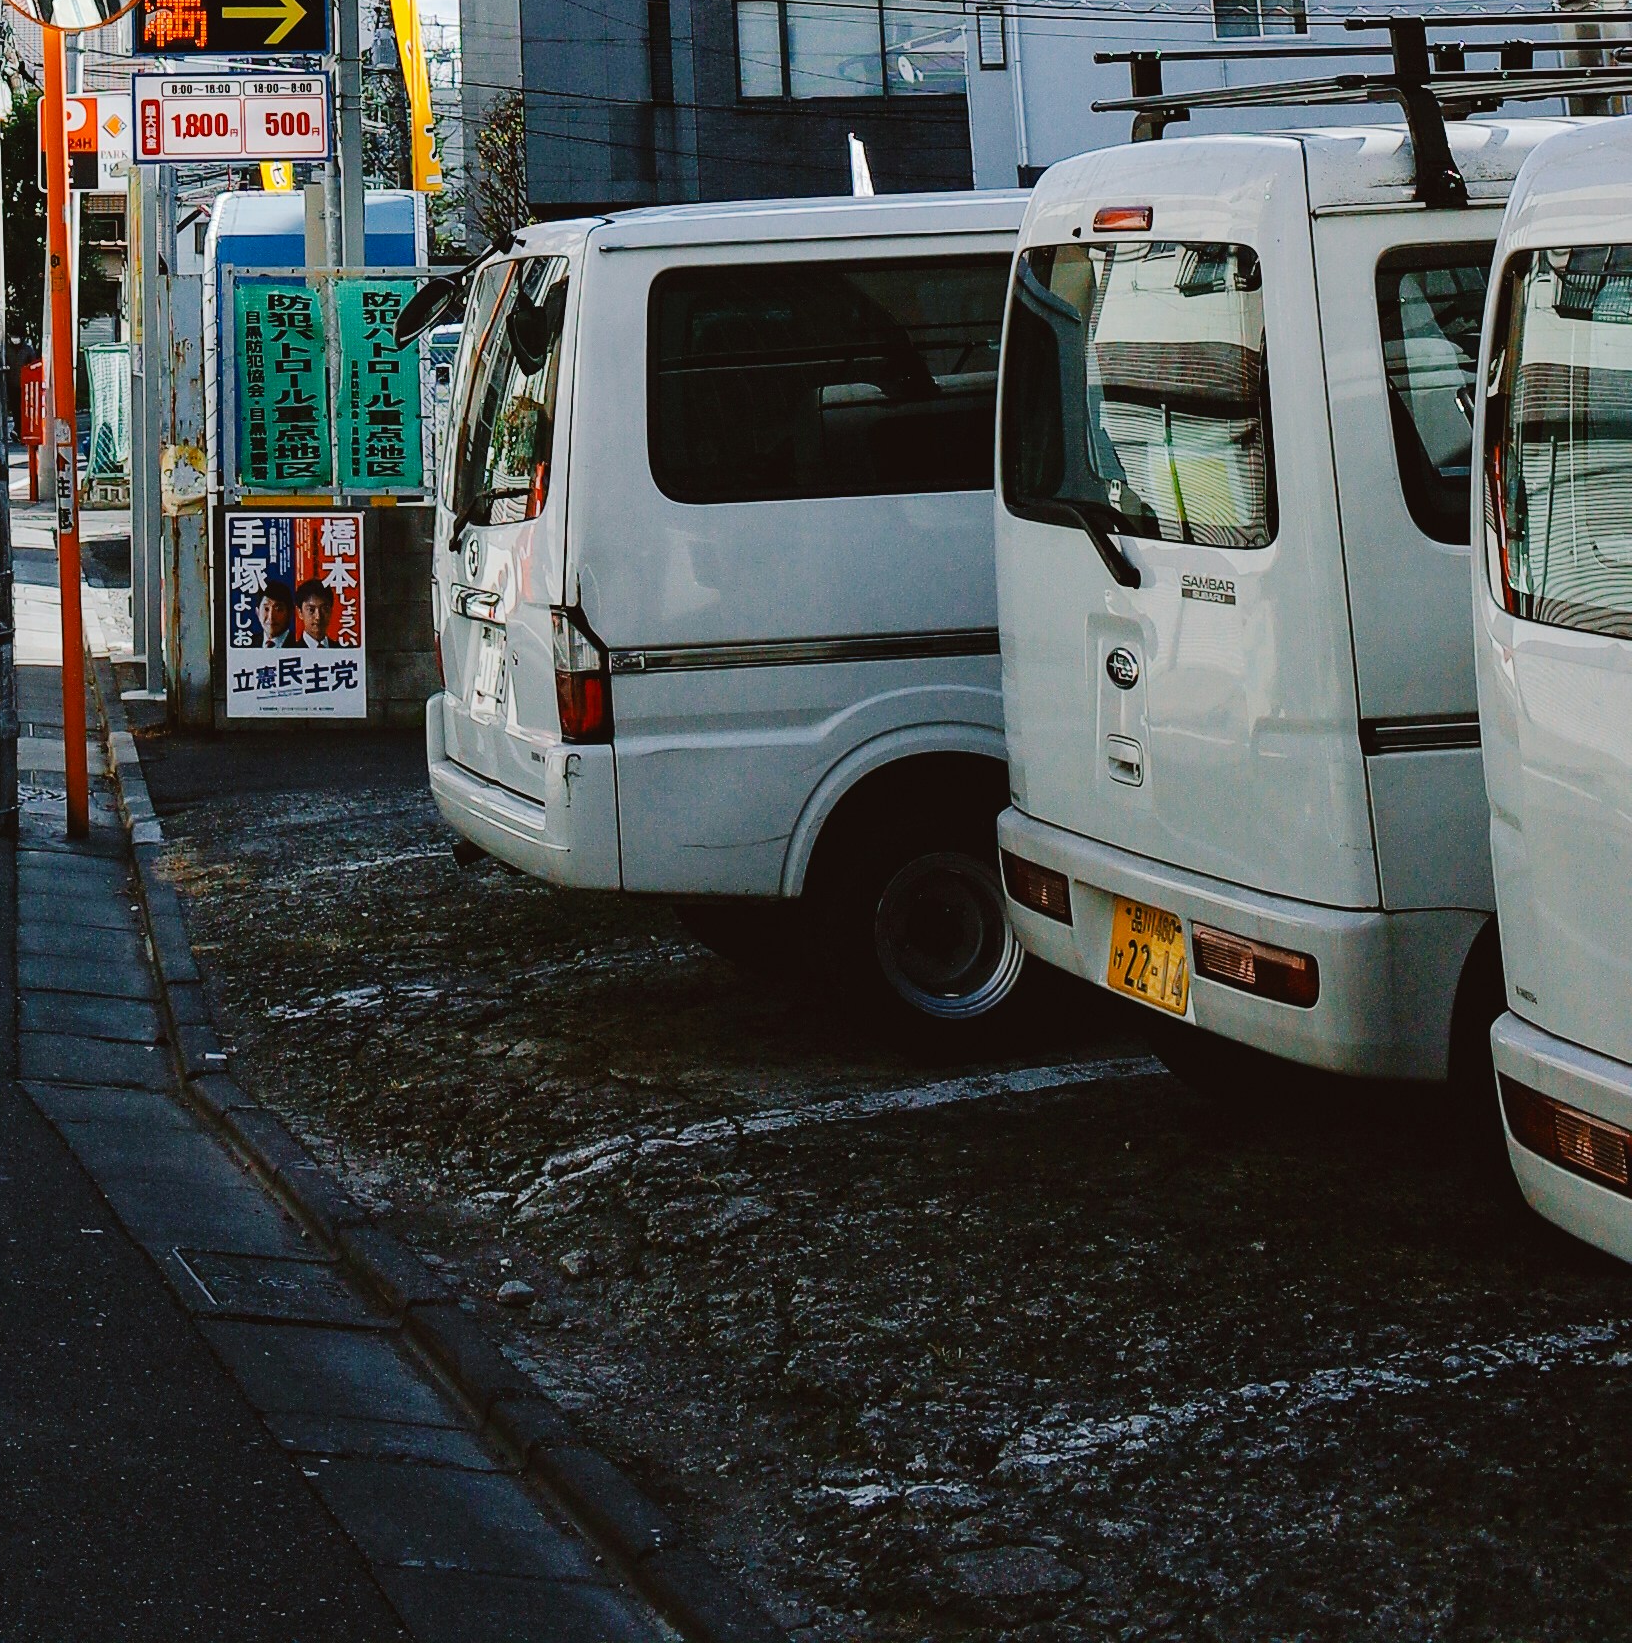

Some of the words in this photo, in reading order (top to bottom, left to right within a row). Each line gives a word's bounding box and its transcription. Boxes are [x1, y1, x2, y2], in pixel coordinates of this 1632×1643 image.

[100, 150, 128, 159] PARK
[267, 293, 321, 480] 防犯パトロール重点地区
[231, 518, 268, 647] 手塚よしお
[320, 518, 358, 647] 橋本しょうへい
[1181, 574, 1236, 593] SAMBAR
[232, 656, 359, 694] 立憲民主党
